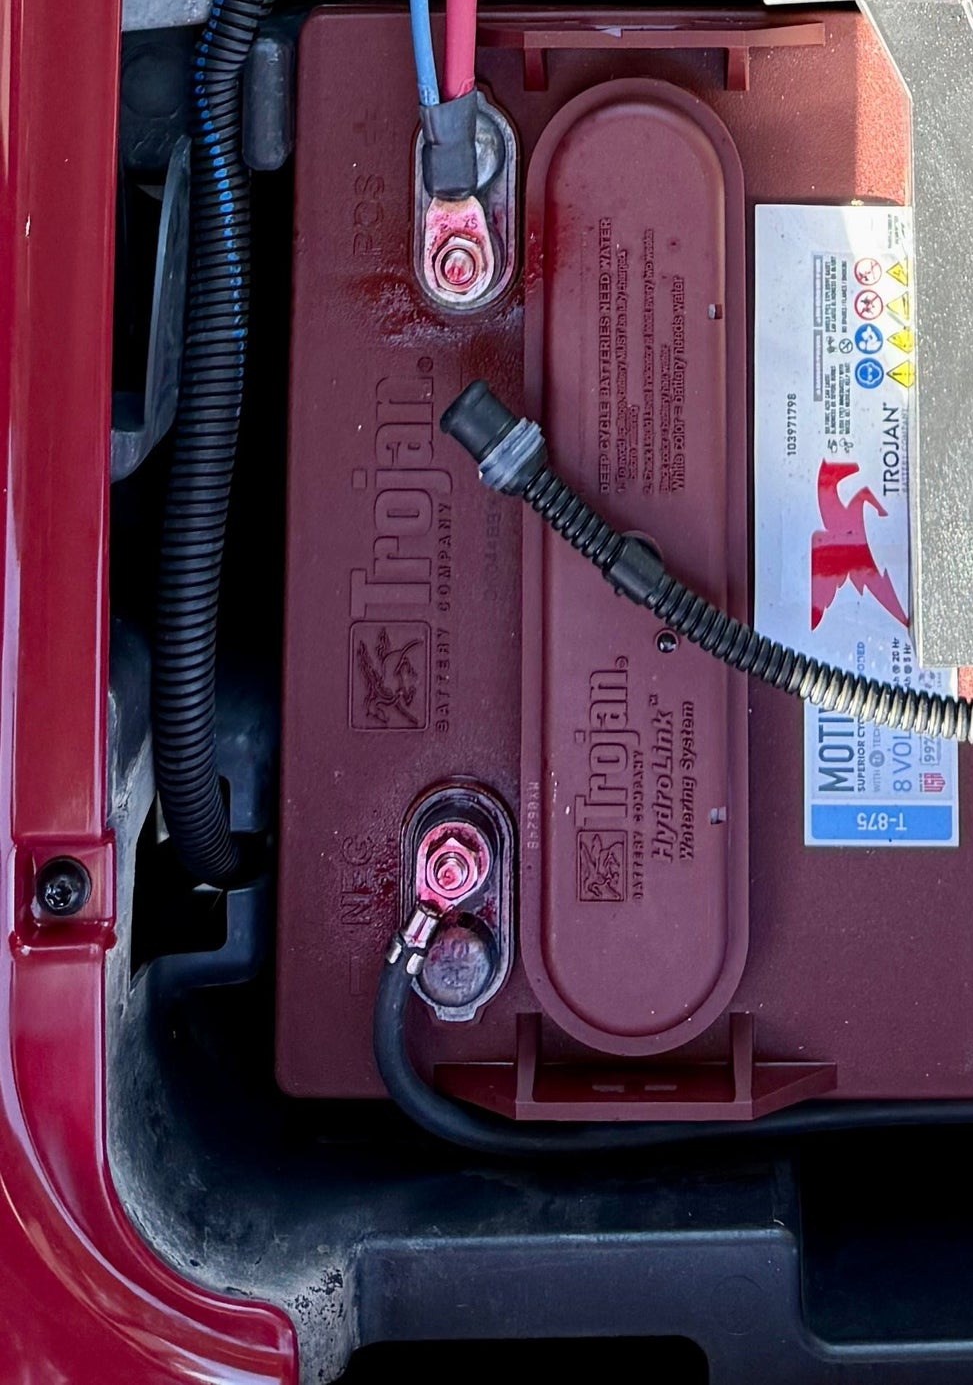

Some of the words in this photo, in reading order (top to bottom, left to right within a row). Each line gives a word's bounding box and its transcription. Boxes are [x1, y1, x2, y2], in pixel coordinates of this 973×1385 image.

[353, 174, 385, 255] POS
[600, 217, 612, 269] WATER
[600, 273, 612, 313] NEED
[672, 276, 685, 312] water
[600, 317, 612, 397] BATTERIES
[616, 330, 627, 361] MUST
[672, 315, 685, 355] needs
[672, 359, 687, 403] battery
[600, 402, 612, 450] CYCLE
[672, 418, 685, 450] color
[786, 393, 797, 457] 103971798
[883, 402, 901, 496] TROJAN
[600, 454, 612, 493] DEEP
[671, 454, 685, 491] White
[437, 501, 453, 612] COMPANY
[892, 638, 900, 648] Hr
[892, 650, 900, 662] 20
[904, 643, 911, 654] Hr
[435, 627, 450, 733] BATTERY
[679, 701, 696, 771] System
[632, 750, 644, 823] COMPANY
[858, 740, 866, 792] SUPERIOR
[873, 770, 881, 792] WITH
[893, 780, 912, 792] 8
[924, 773, 946, 792] USA
[680, 776, 697, 860] Watering
[857, 812, 907, 831] T-875
[340, 836, 373, 925] NEG
[632, 831, 644, 900] BATTERY
